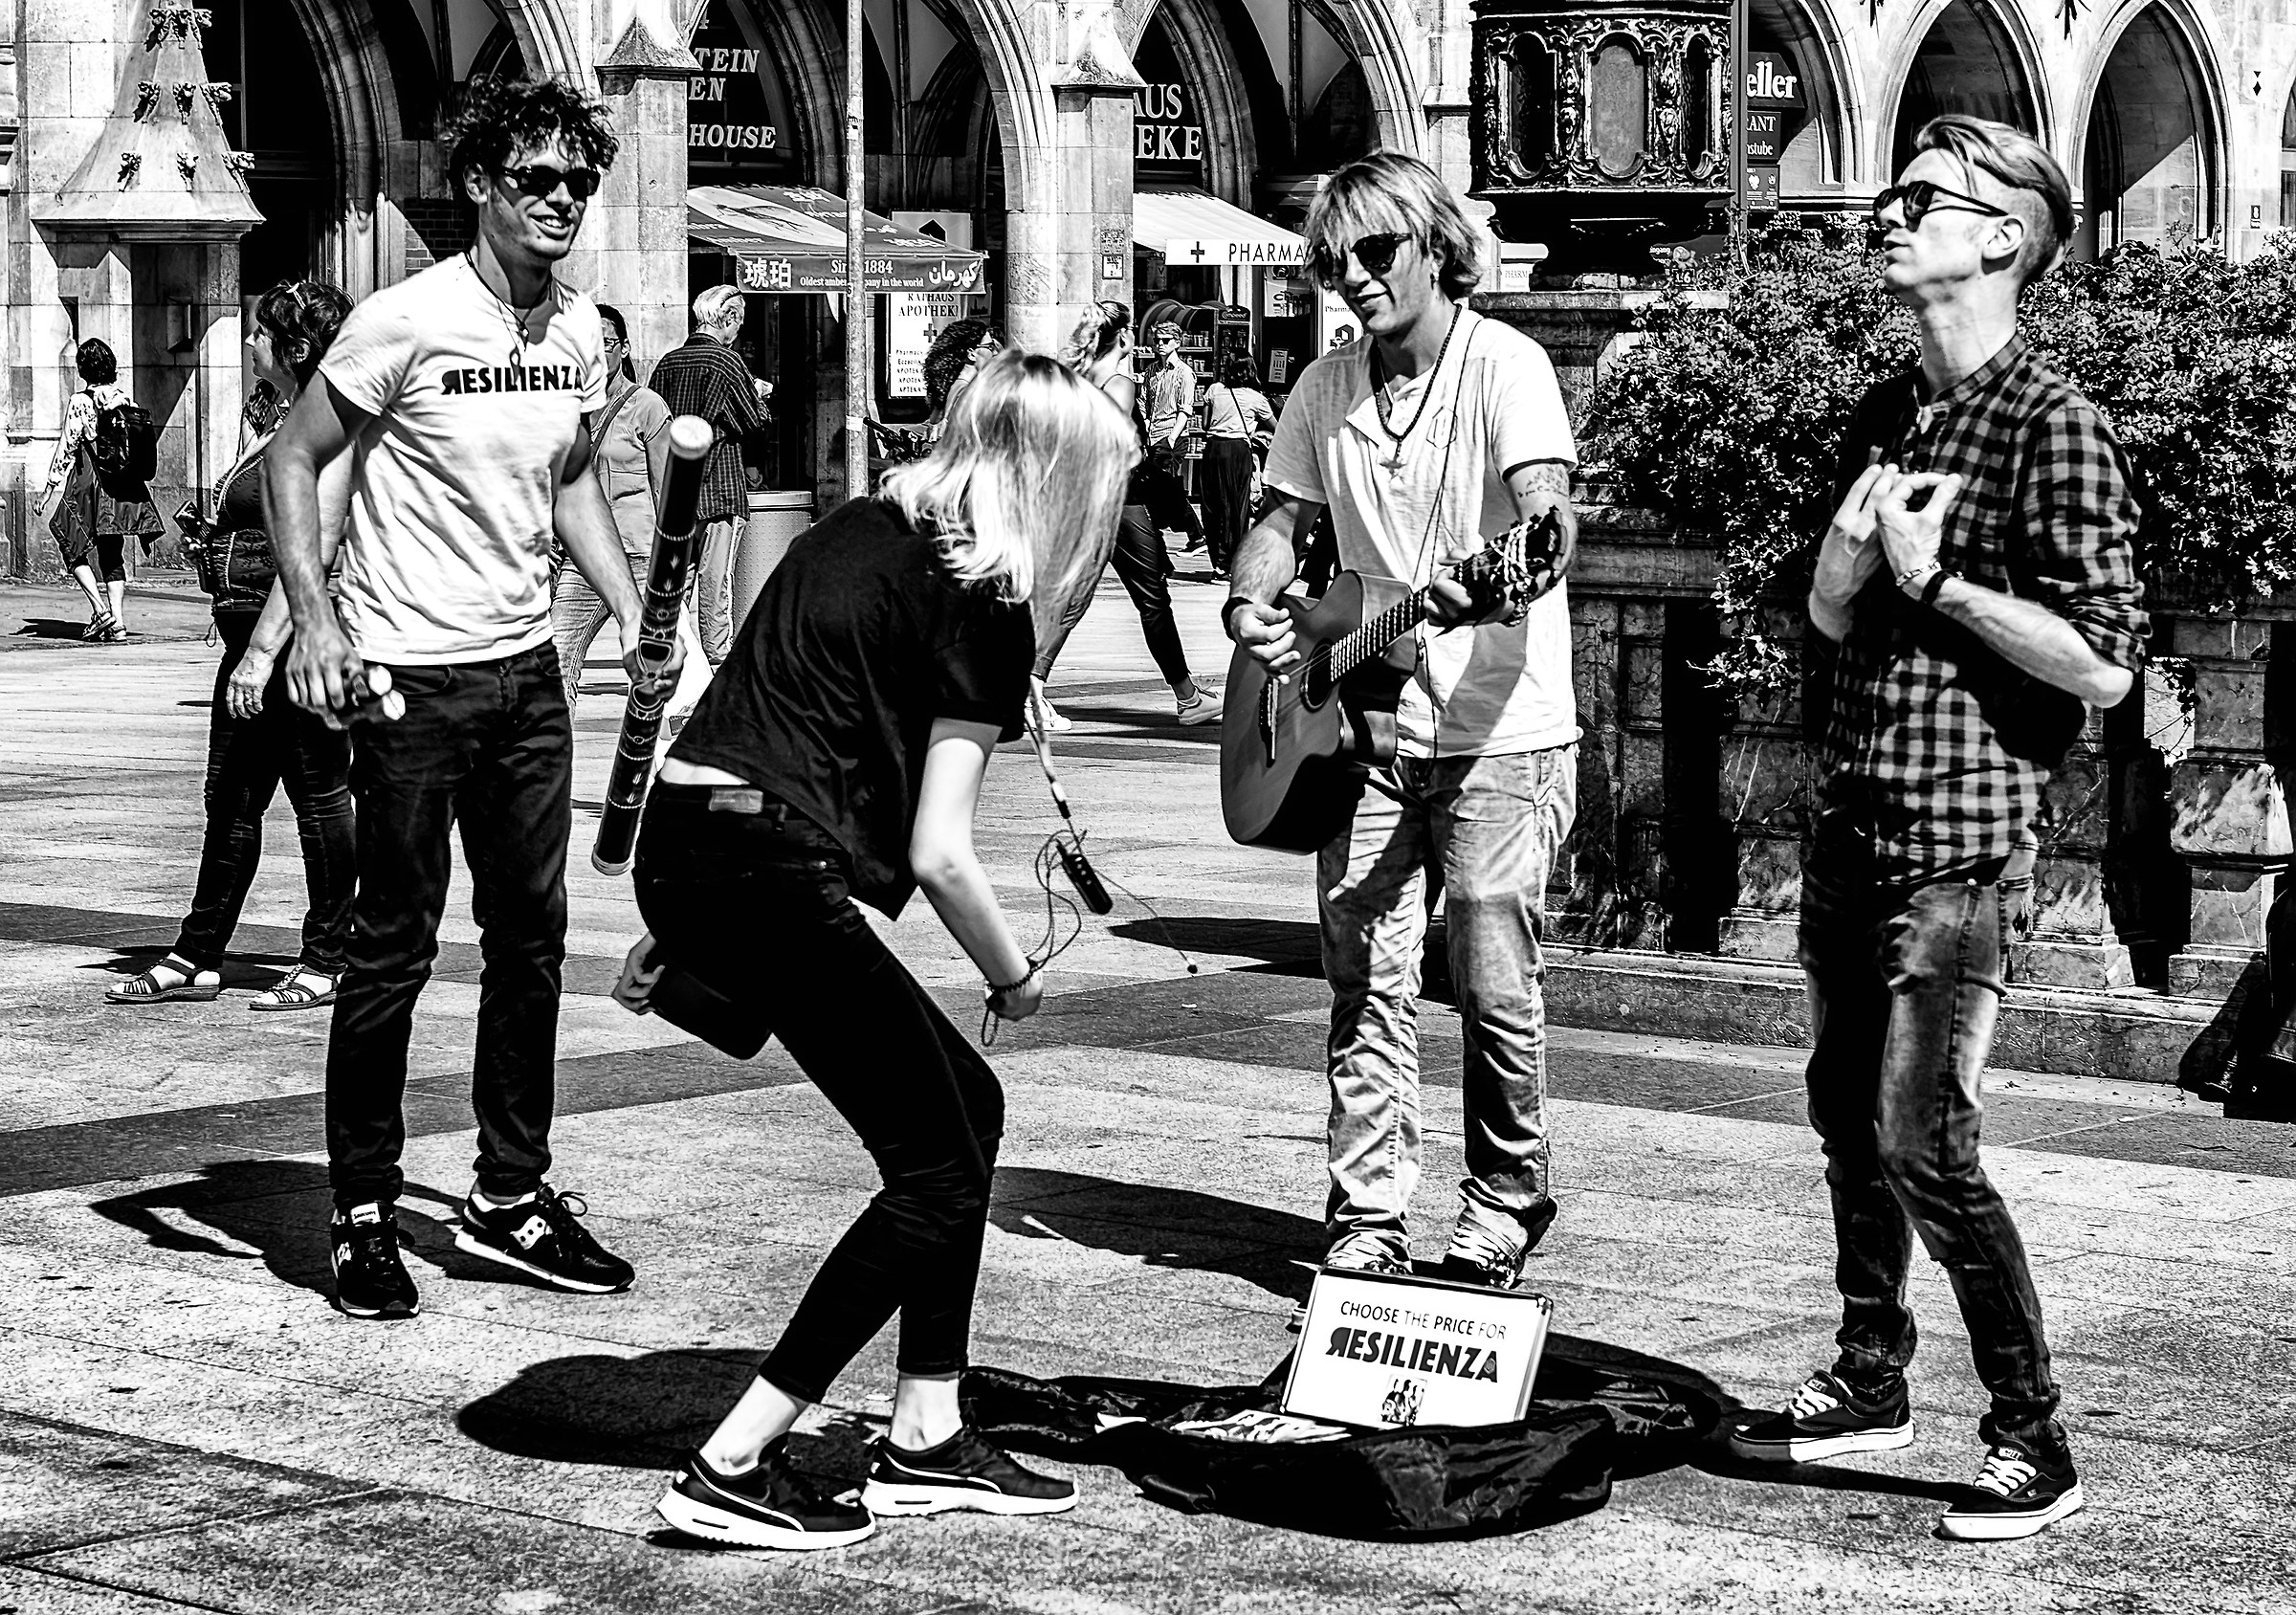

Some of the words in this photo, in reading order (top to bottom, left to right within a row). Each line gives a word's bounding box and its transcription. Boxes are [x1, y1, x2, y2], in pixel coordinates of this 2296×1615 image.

[694, 48, 761, 74] TEIN
[688, 77, 727, 101] EN
[1746, 60, 1798, 99] eller
[688, 123, 777, 149] HOUSE
[1746, 115, 1777, 132] ANT
[1135, 124, 1203, 161] EKE
[1228, 243, 1306, 263] PHARMA
[743, 256, 792, 289] 琥珀
[864, 259, 894, 274] 1884
[800, 277, 824, 287] Oldest
[882, 277, 891, 287] in
[891, 277, 902, 287] the
[903, 277, 924, 288] world
[1340, 1300, 1400, 1323] CHOOSE
[1404, 1310, 1428, 1329] THE
[1434, 1316, 1474, 1336] PRICE
[1479, 1322, 1507, 1340] FOR
